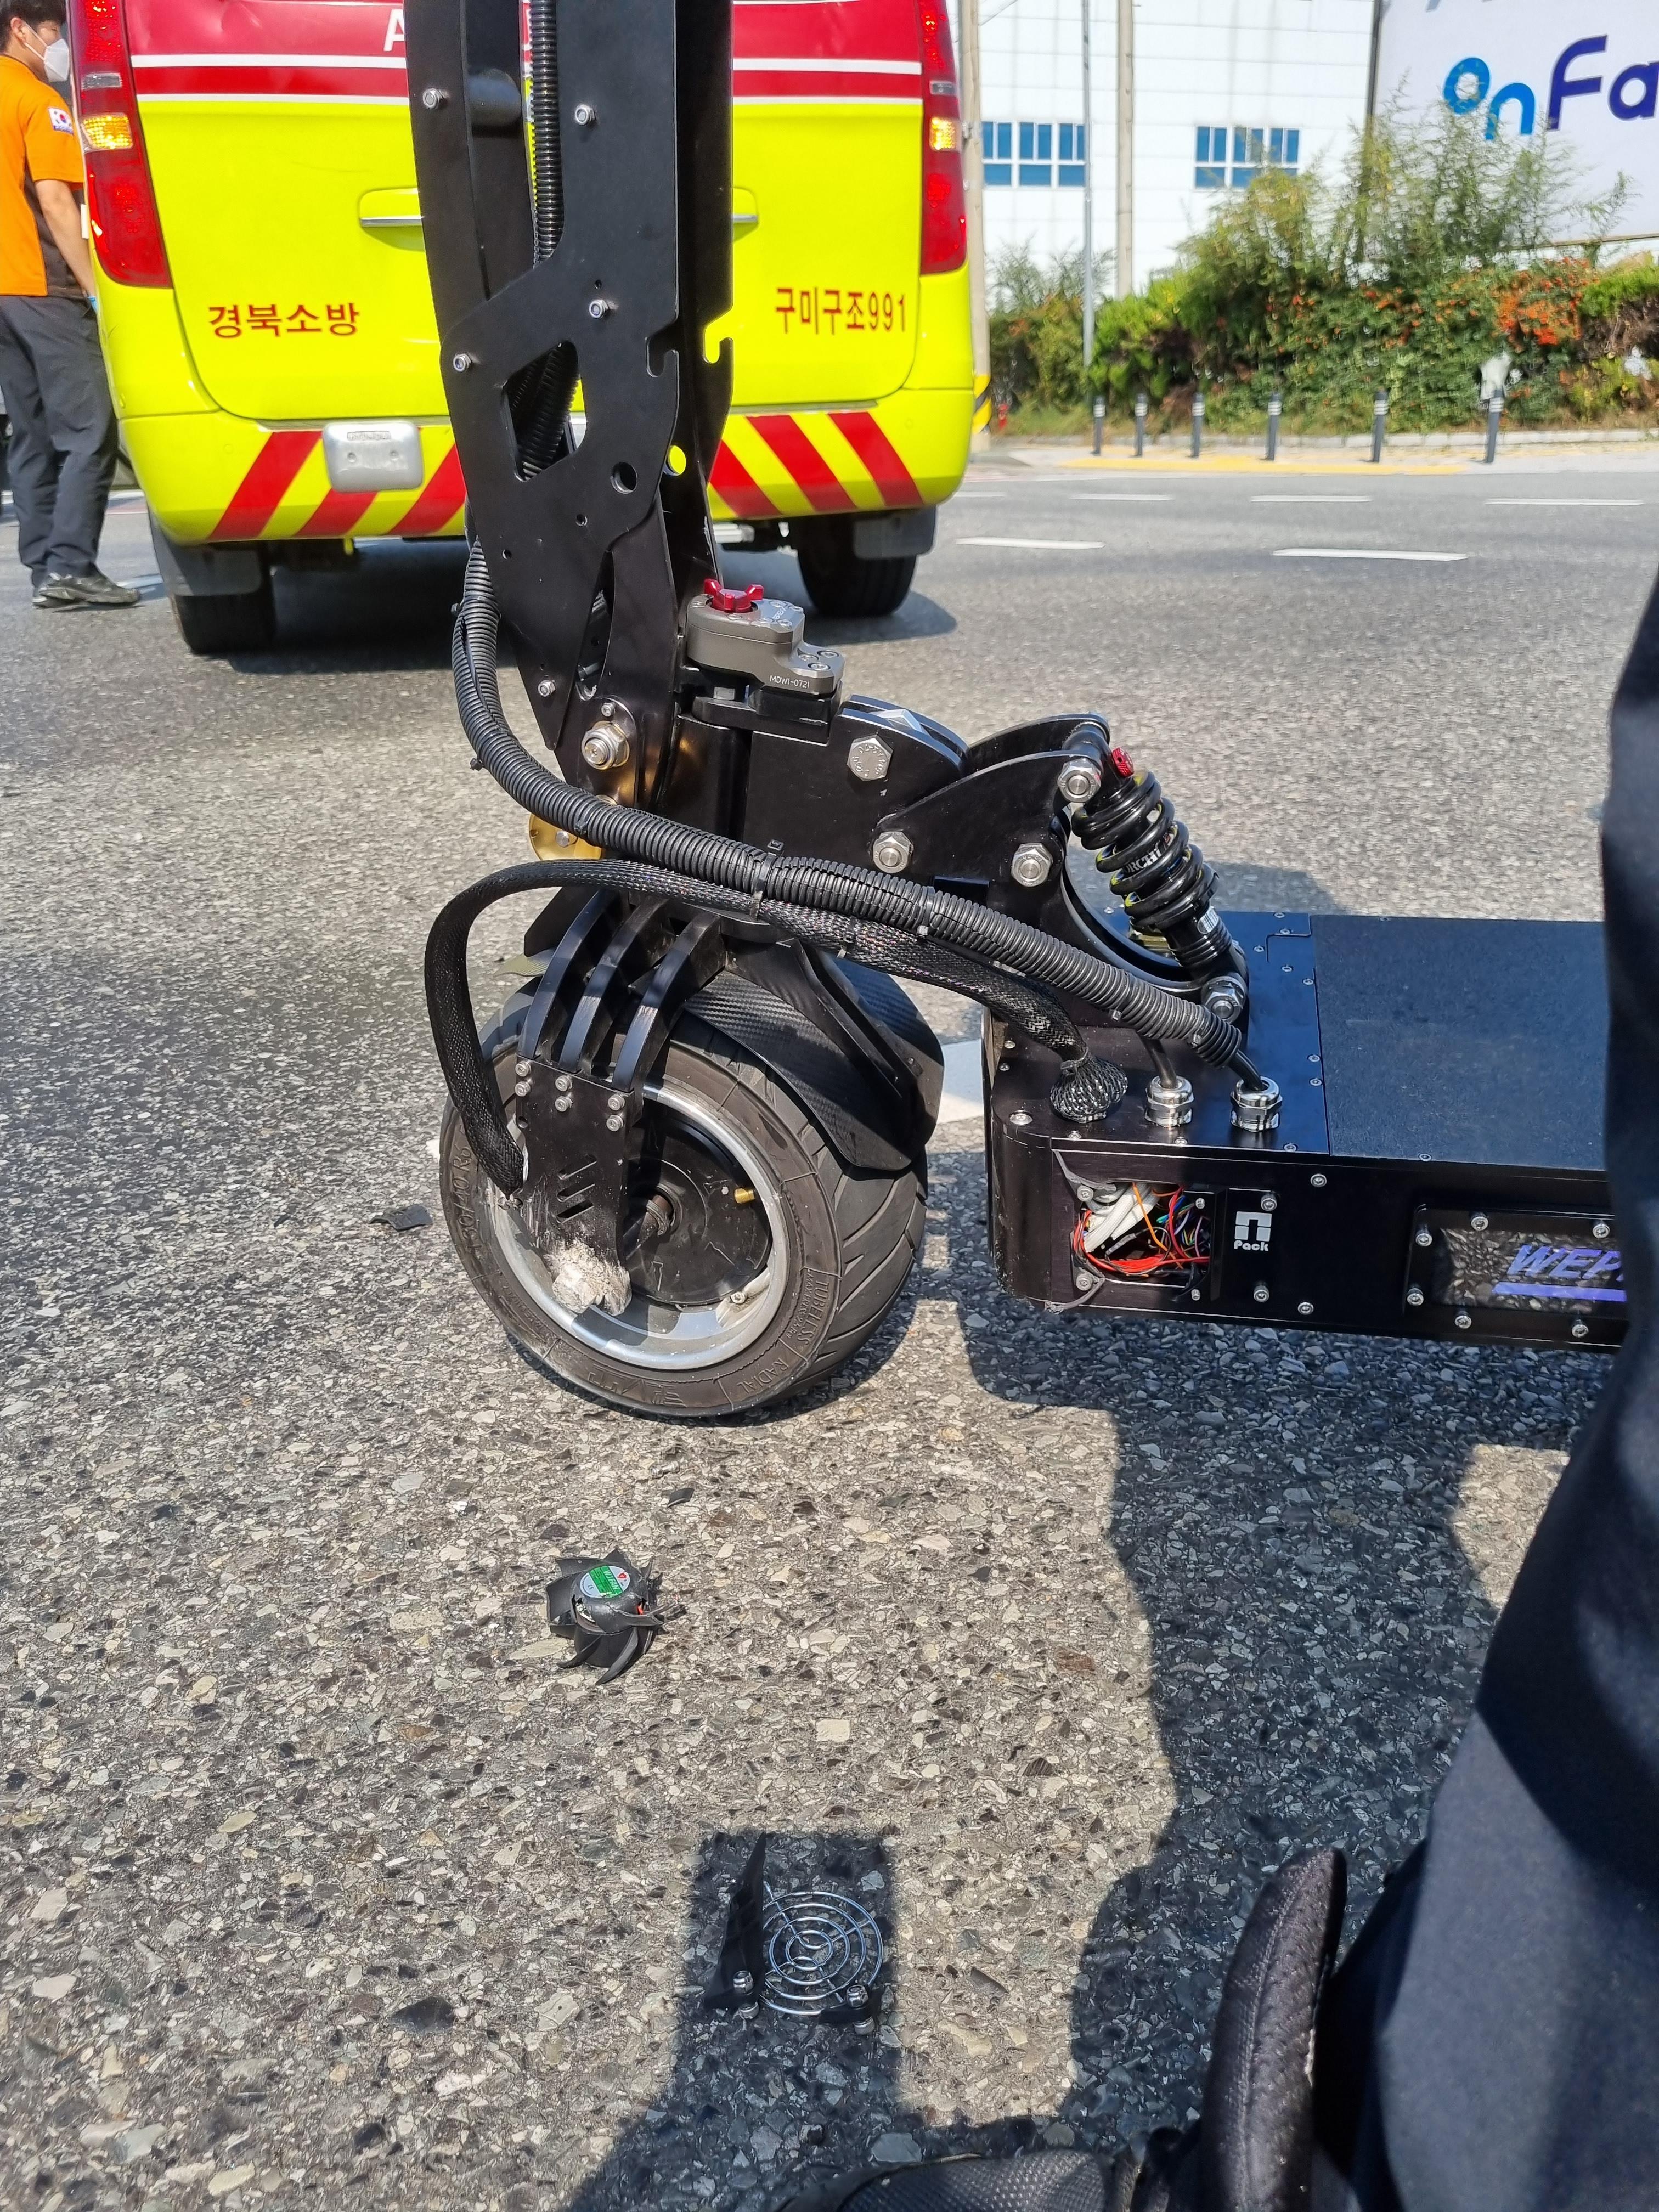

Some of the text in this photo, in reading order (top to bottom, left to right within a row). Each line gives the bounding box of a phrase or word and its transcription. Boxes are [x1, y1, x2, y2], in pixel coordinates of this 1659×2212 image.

[208, 302, 360, 338] 경북소방
[1233, 1240, 1269, 1251] Pack
[1506, 1244, 1624, 1282] WEP
[737, 1358, 788, 1395] RADIAL
